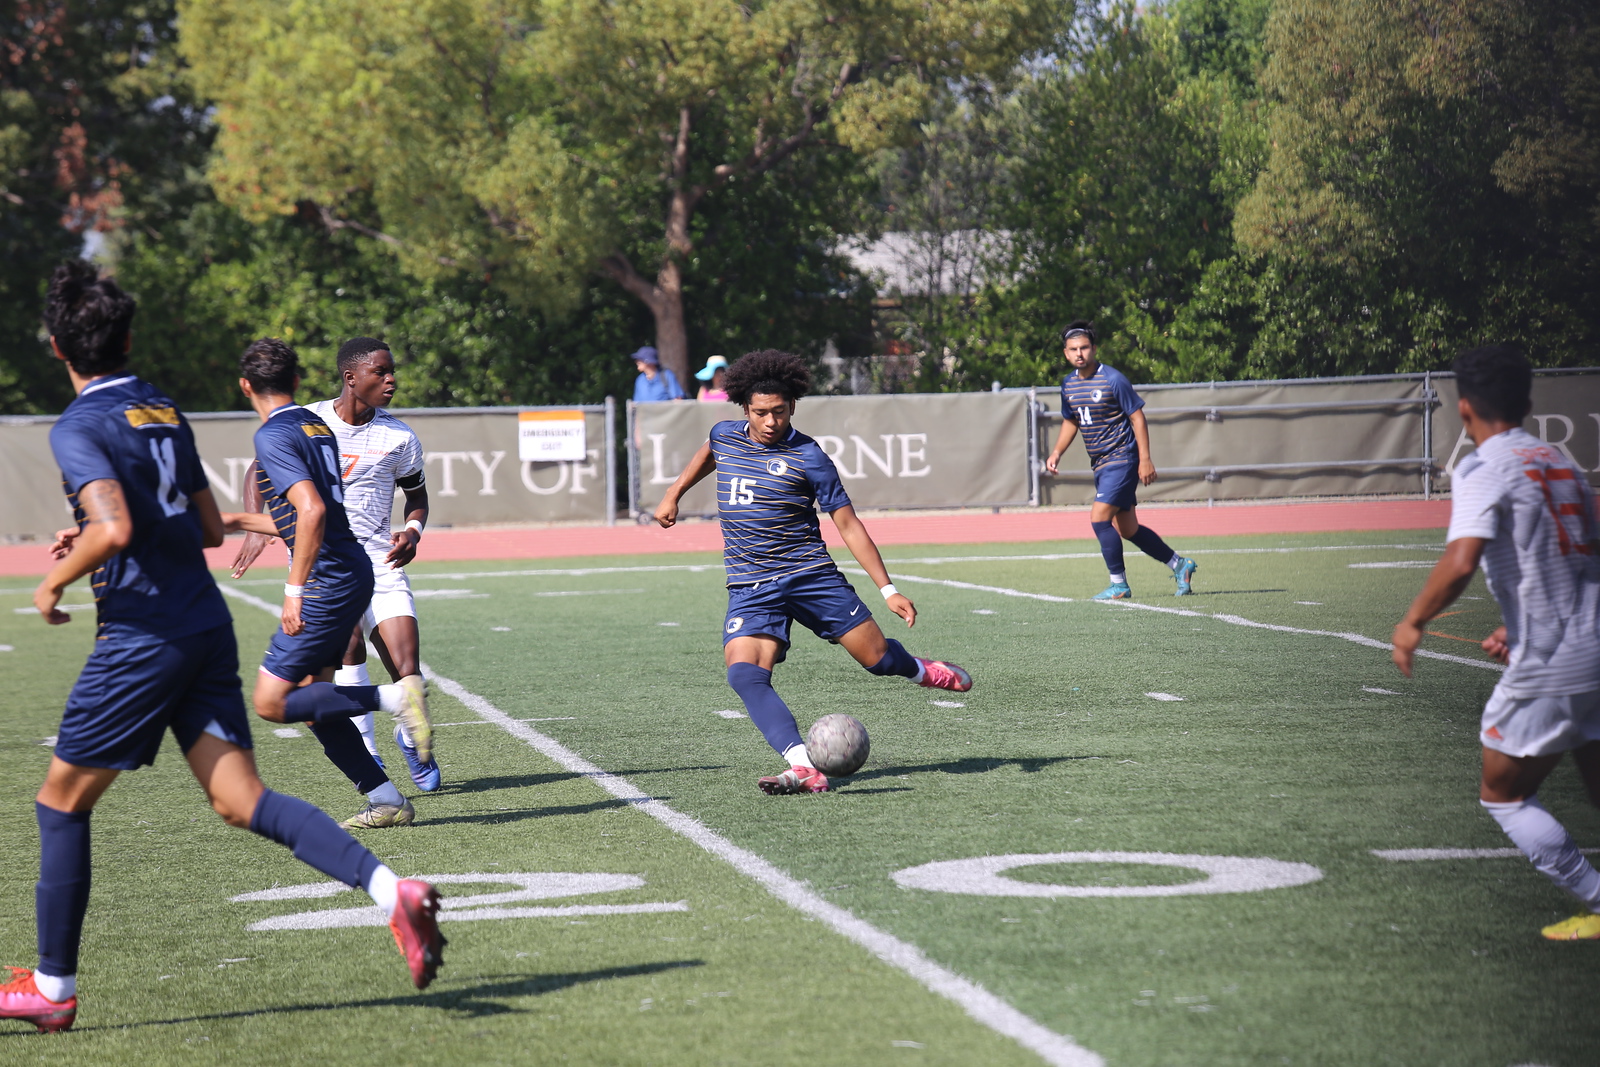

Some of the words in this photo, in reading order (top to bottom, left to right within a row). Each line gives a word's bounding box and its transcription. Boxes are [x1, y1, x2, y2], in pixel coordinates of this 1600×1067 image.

[520, 448, 599, 495] OF
[813, 433, 931, 479] RNE
[728, 477, 757, 505] 15
